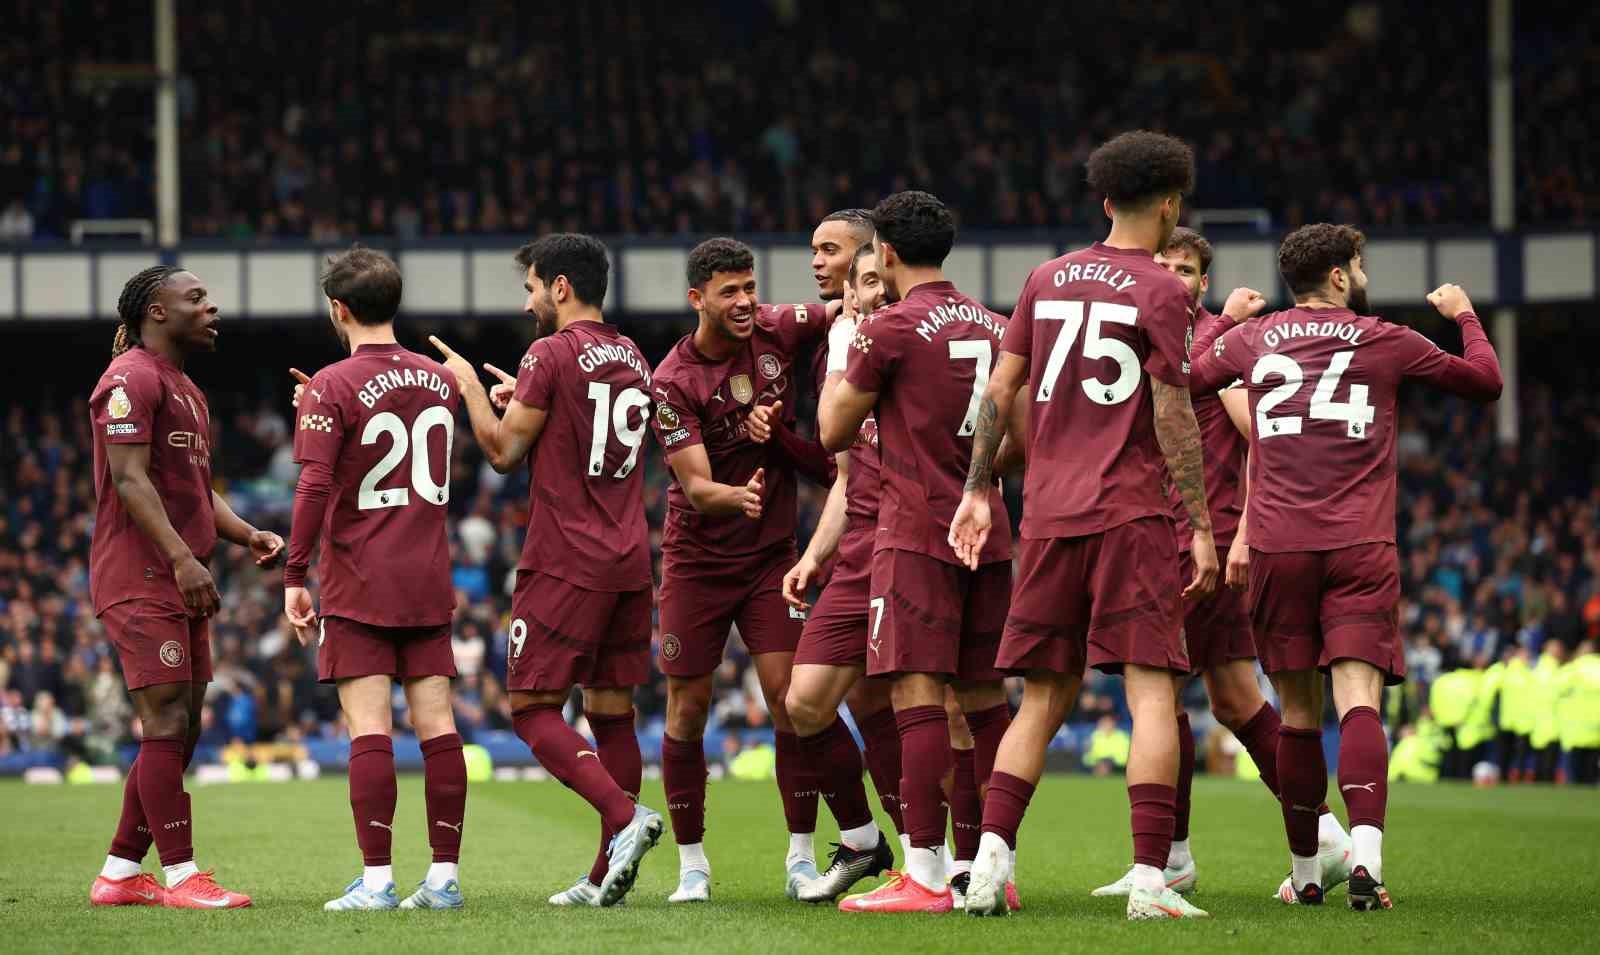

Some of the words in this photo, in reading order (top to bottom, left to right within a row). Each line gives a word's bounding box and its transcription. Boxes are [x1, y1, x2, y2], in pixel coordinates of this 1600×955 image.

[1054, 262, 1136, 291] O'REILLY
[916, 304, 1006, 342] MARMOUSH
[1034, 300, 1141, 405] 75
[1263, 322, 1364, 347] GVARDIOL
[358, 368, 450, 409] BERNARDO
[948, 339, 992, 436] 7
[1251, 350, 1376, 440] 24
[358, 406, 454, 511] 20
[587, 381, 650, 478] 19
[870, 597, 885, 640] 7
